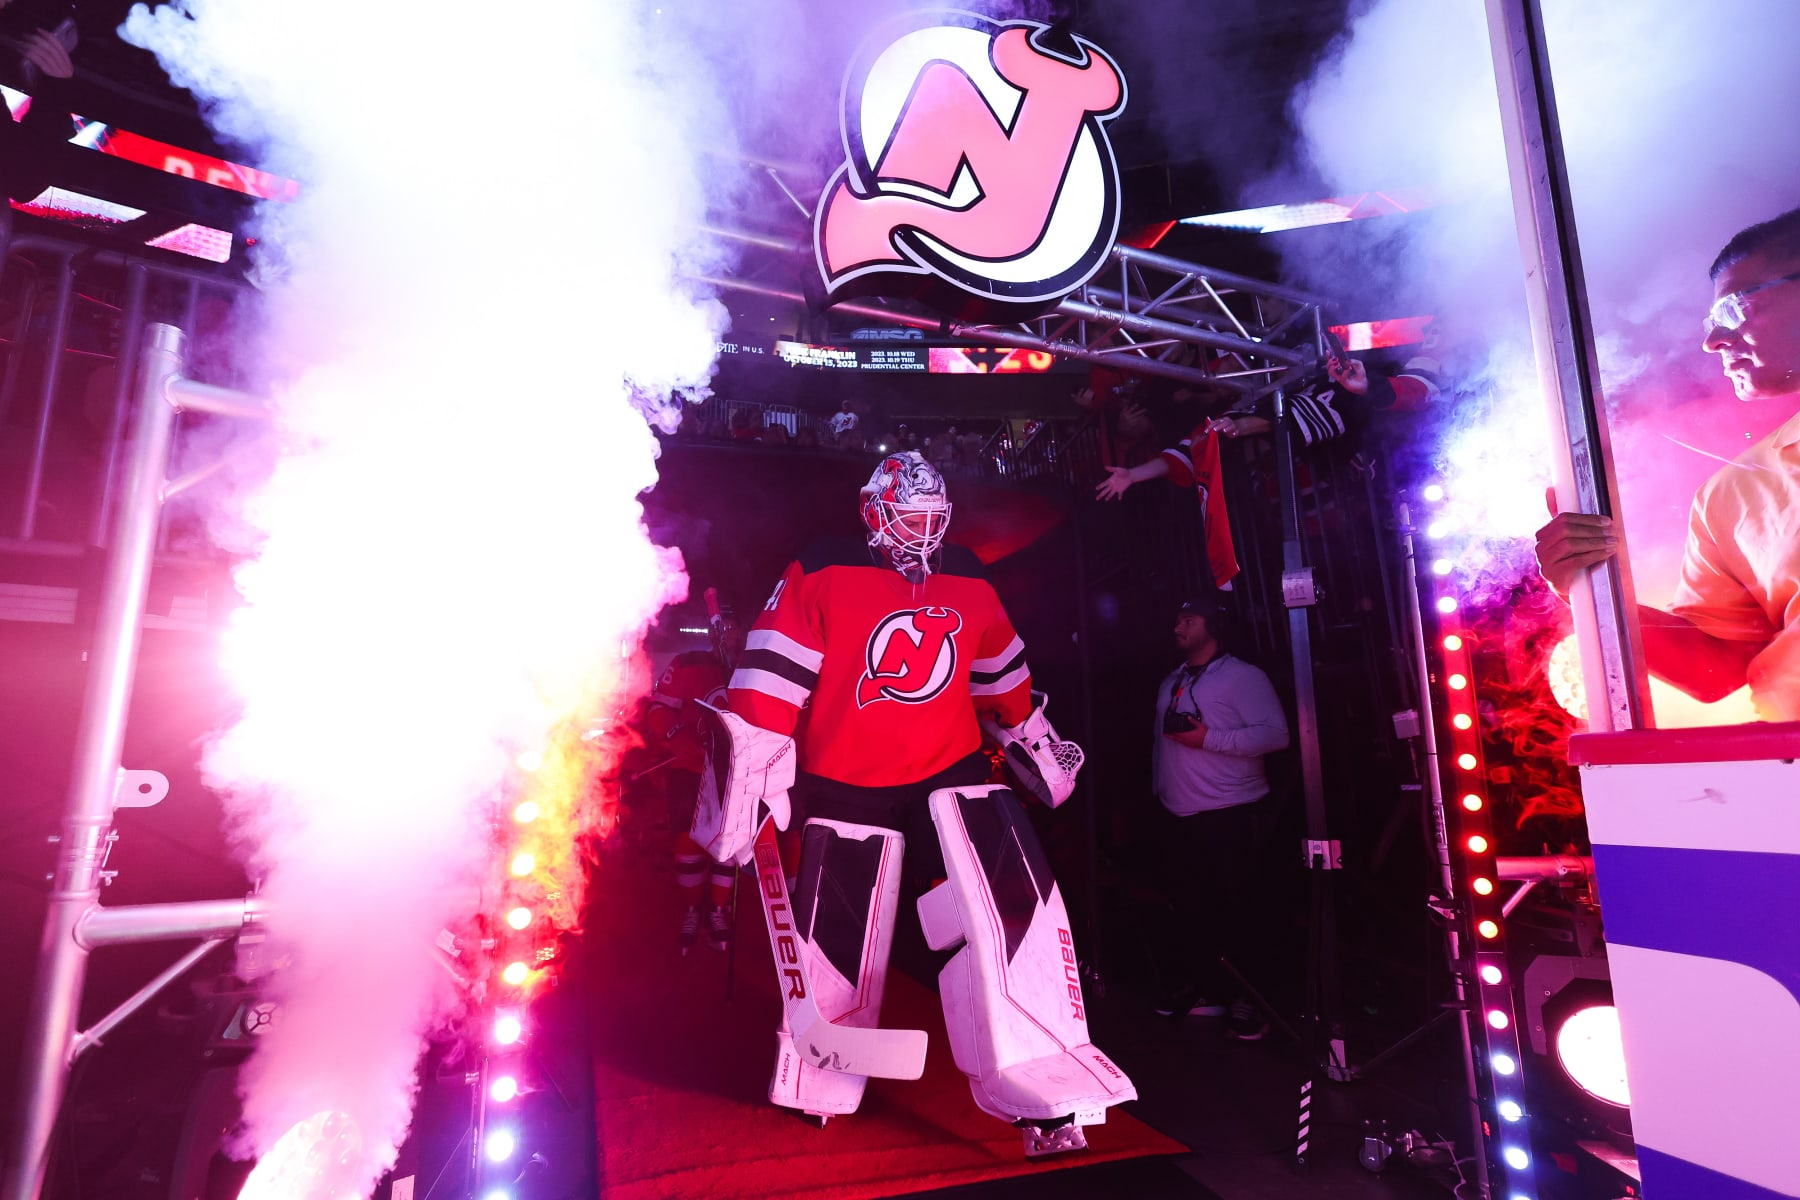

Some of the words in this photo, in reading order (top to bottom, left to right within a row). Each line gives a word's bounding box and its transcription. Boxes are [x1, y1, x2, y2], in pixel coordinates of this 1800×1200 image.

[836, 360, 858, 369] 2023
[781, 1052, 791, 1086] MACH
[1091, 1054, 1122, 1080] MACH
